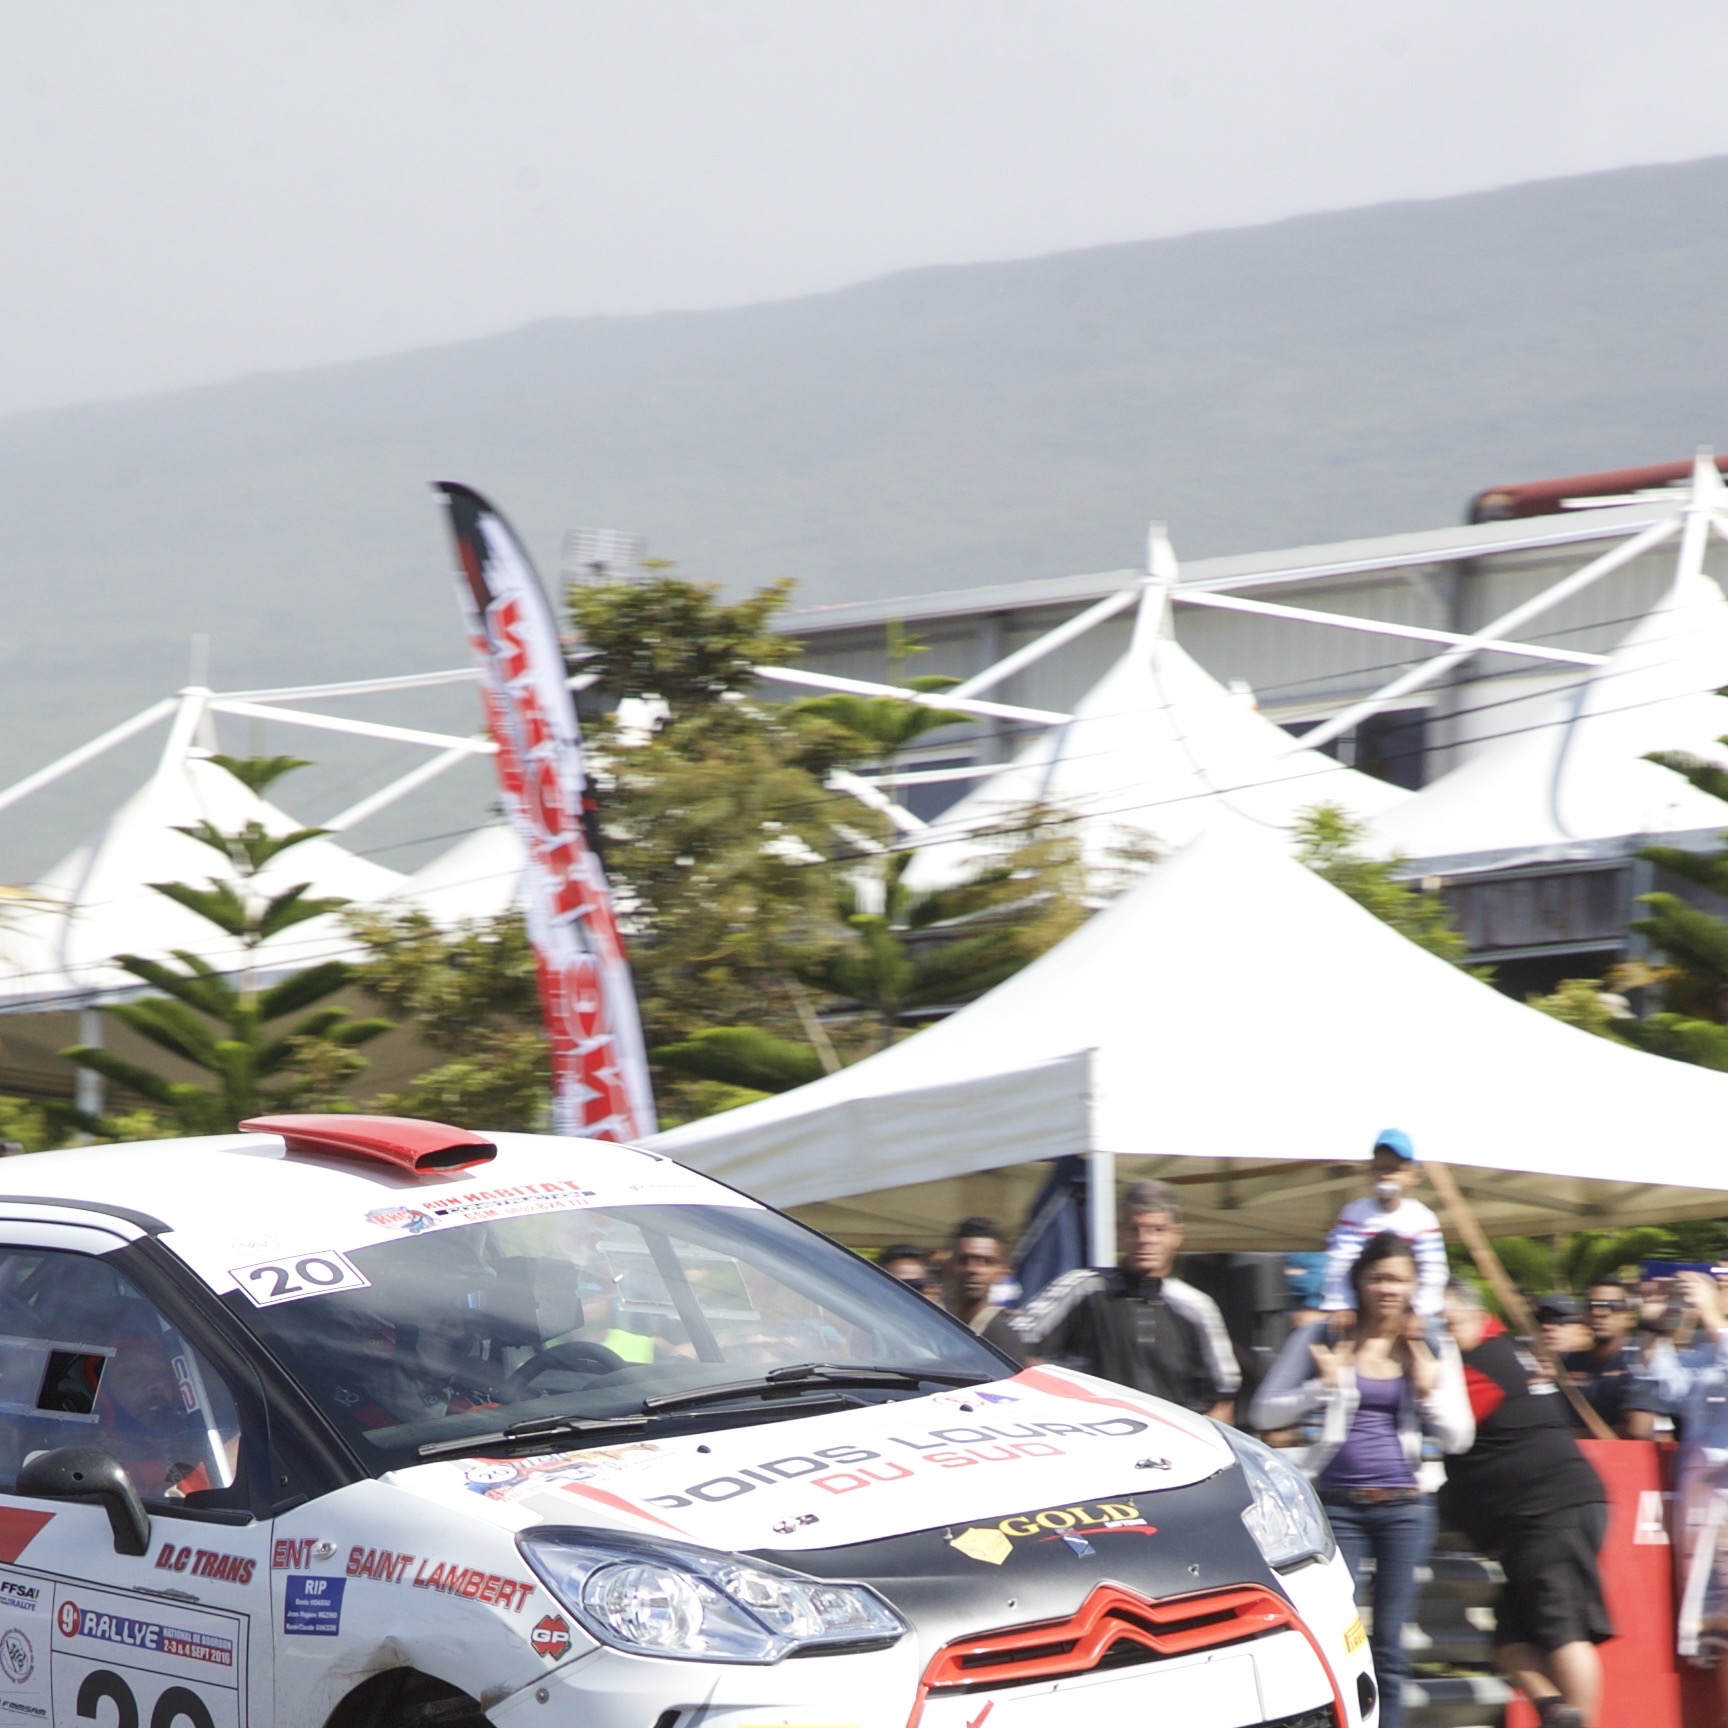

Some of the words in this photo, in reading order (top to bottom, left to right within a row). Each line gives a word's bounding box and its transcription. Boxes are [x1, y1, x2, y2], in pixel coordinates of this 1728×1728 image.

[249, 1258, 344, 1297] 20
[887, 1418, 1149, 1450] LOURD
[810, 1461, 915, 1495] DU
[921, 1442, 1067, 1468] SUD
[999, 1503, 1141, 1537] GOLD
[194, 1549, 256, 1586] TRANS
[272, 1538, 318, 1569] ENT
[346, 1545, 416, 1583] SAINT
[412, 1558, 536, 1614] LAMBERT
[304, 1579, 327, 1595] RIP
[83, 1611, 160, 1648] RALLYE
[532, 1628, 570, 1643] GP
[184, 1643, 191, 1656] 4
[191, 1645, 210, 1660] SEPT
[210, 1649, 231, 1665] 2016
